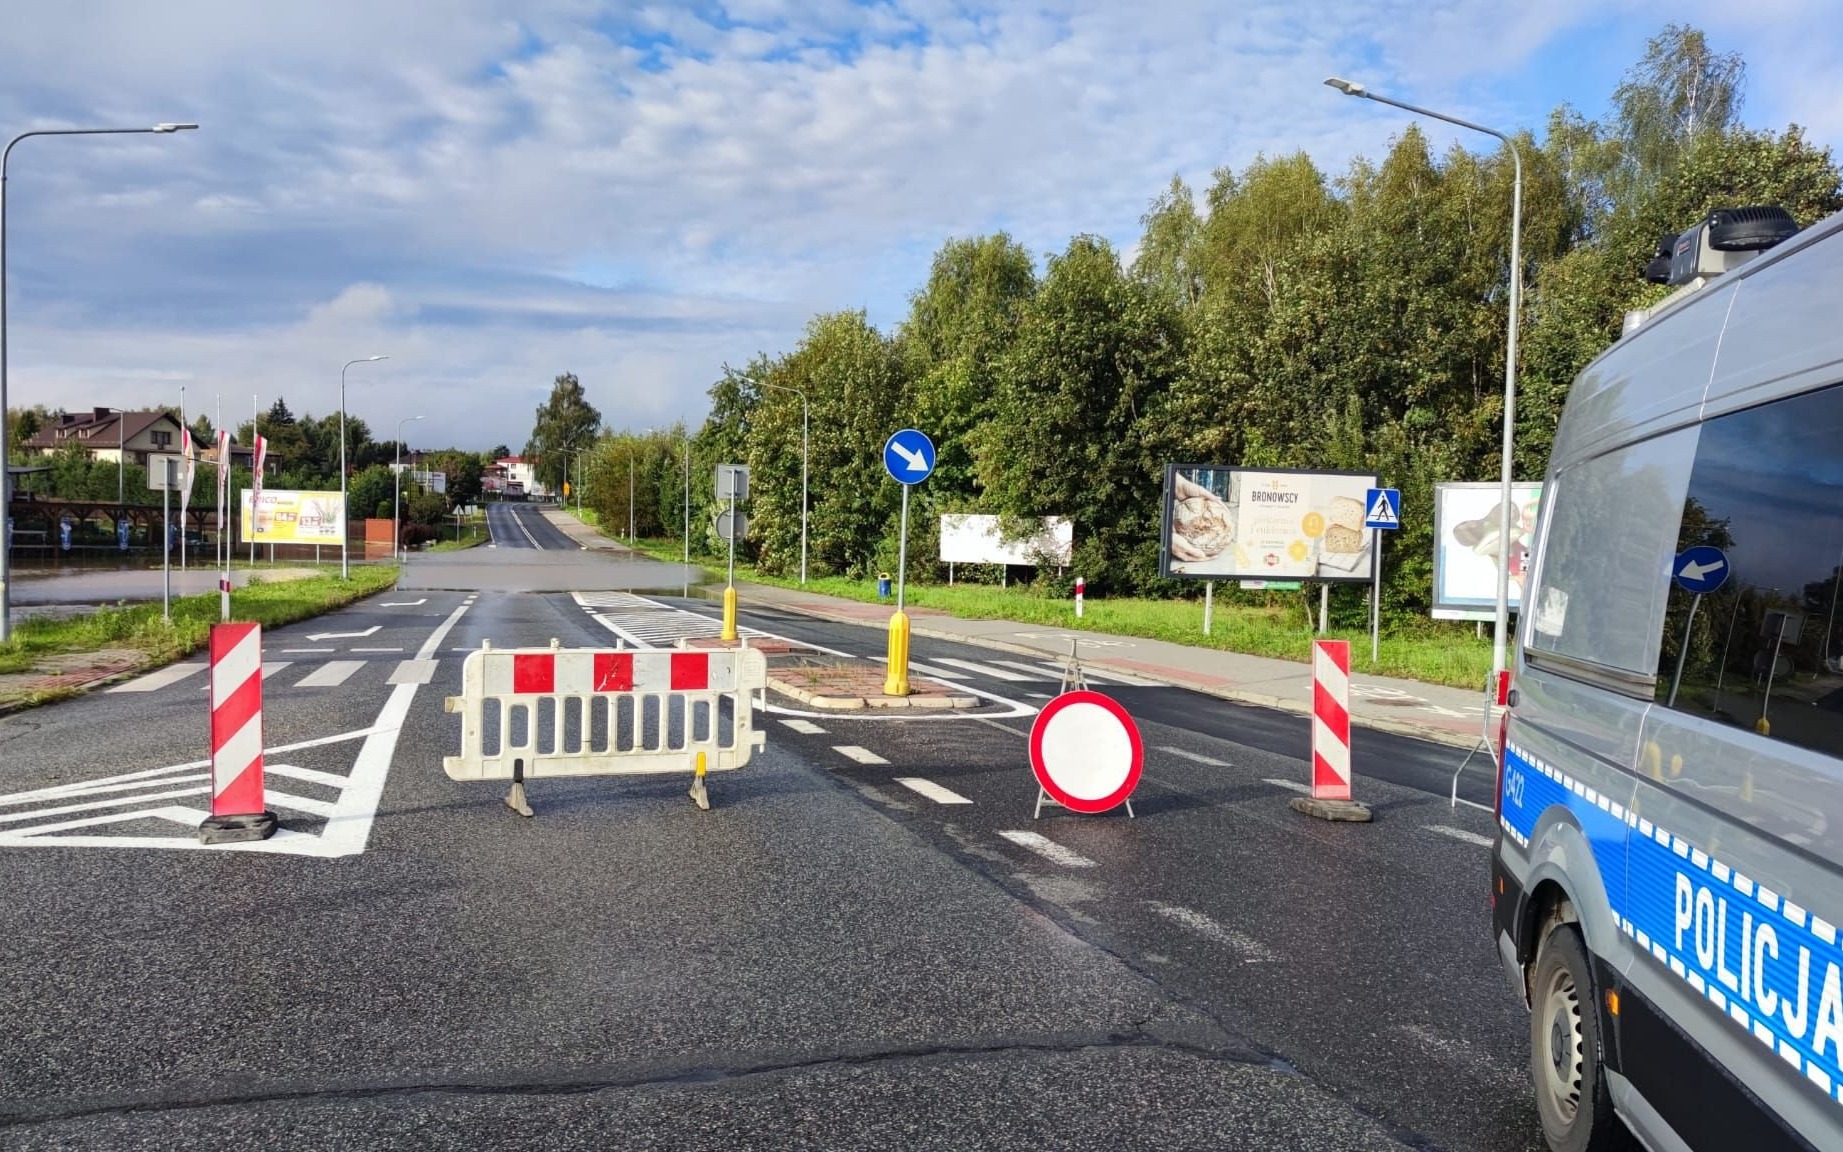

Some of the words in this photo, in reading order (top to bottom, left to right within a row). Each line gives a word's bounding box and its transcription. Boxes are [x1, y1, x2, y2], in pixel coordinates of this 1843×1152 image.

[1251, 491, 1299, 504] BRONOWSCY
[1505, 764, 1525, 809] G422
[1675, 871, 1843, 1073] POLICJA
